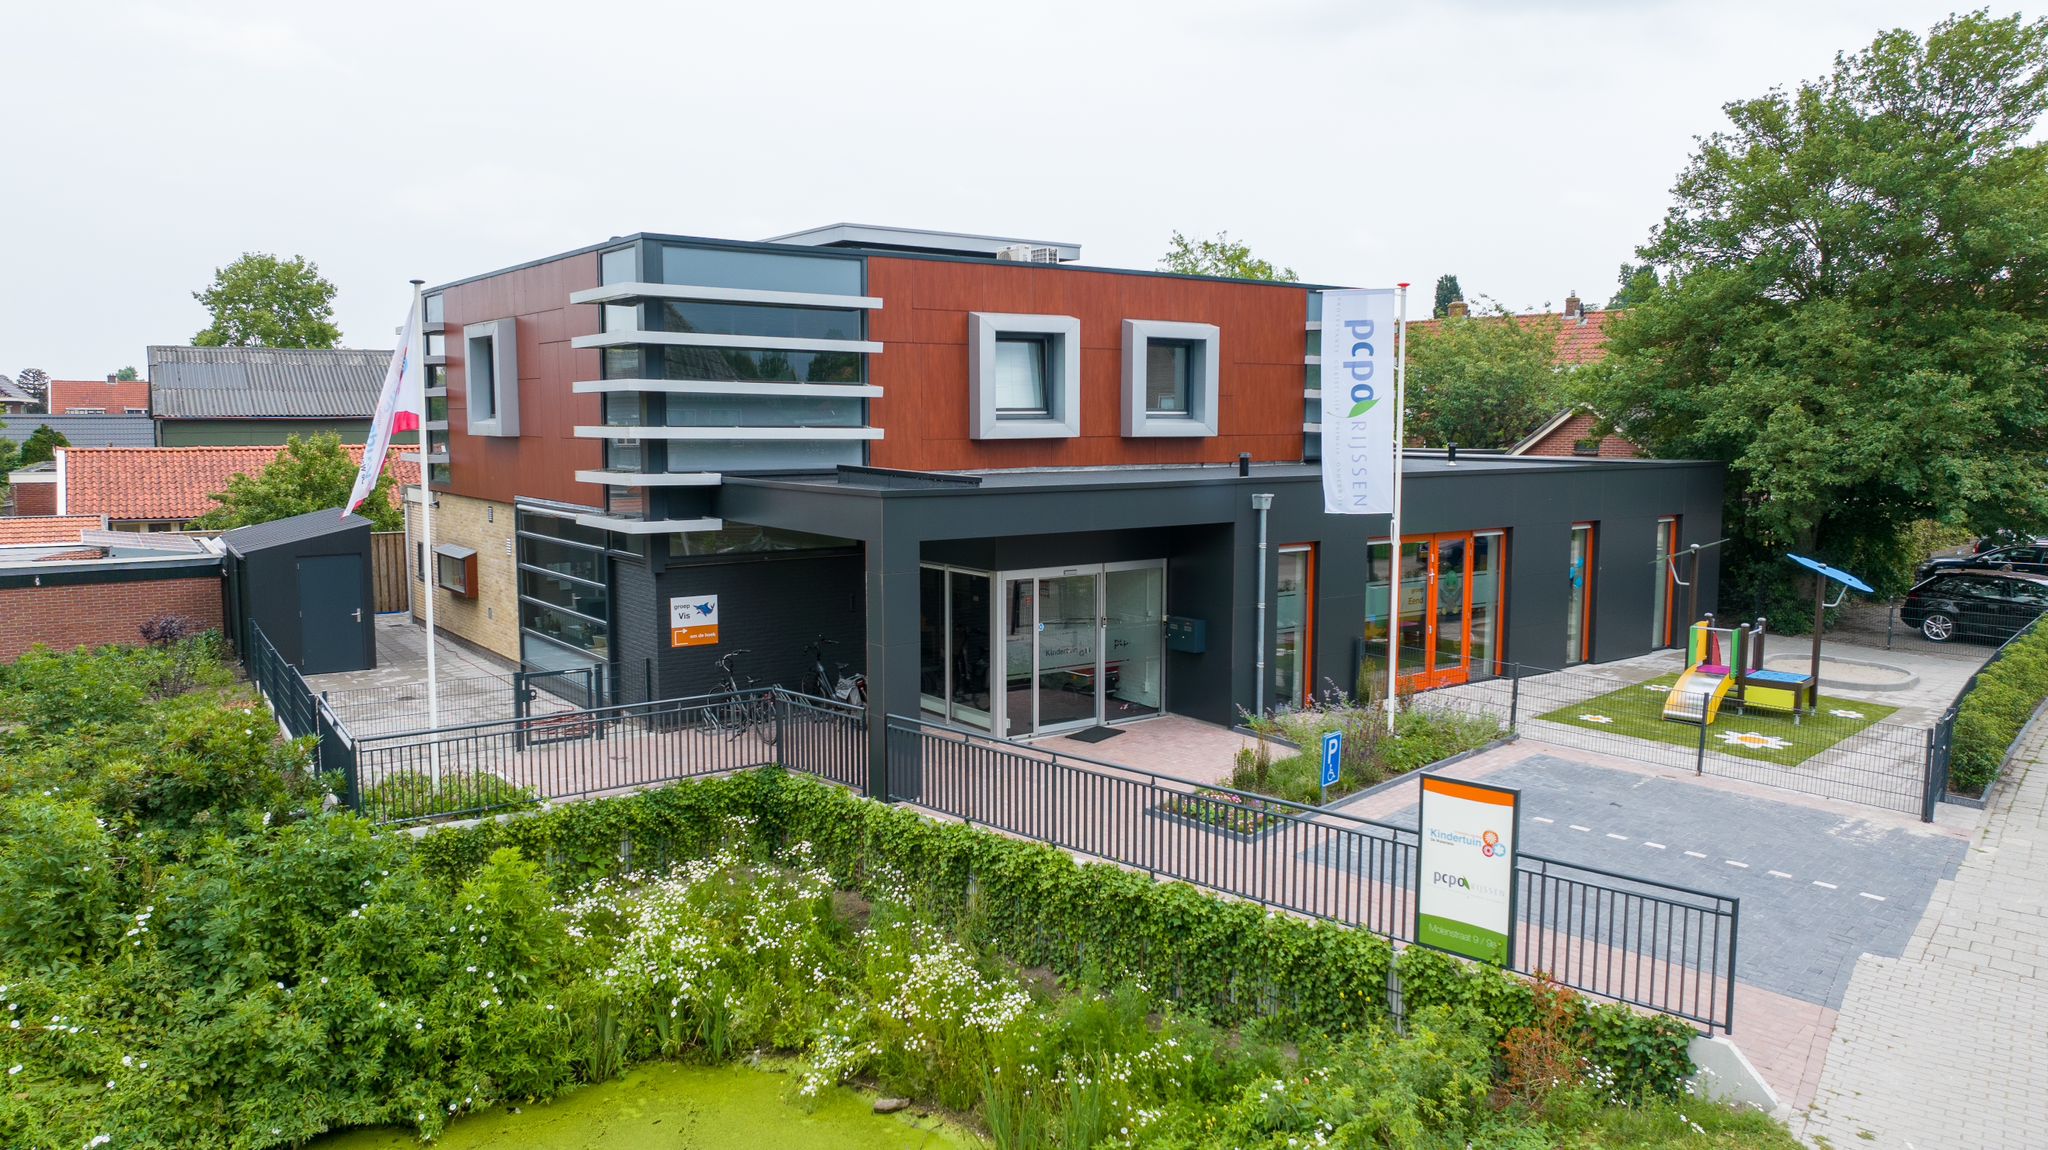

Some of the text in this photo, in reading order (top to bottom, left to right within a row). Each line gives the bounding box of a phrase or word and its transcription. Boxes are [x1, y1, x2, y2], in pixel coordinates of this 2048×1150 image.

[1343, 319, 1375, 506] pcpo RIJSSEN
[1407, 597, 1424, 605] Eend
[678, 612, 691, 620] Vis
[1328, 738, 1338, 764] P
[1430, 828, 1482, 847] Kindertuin
[1433, 871, 1465, 888] pcpo
[1472, 935, 1479, 944] 9
